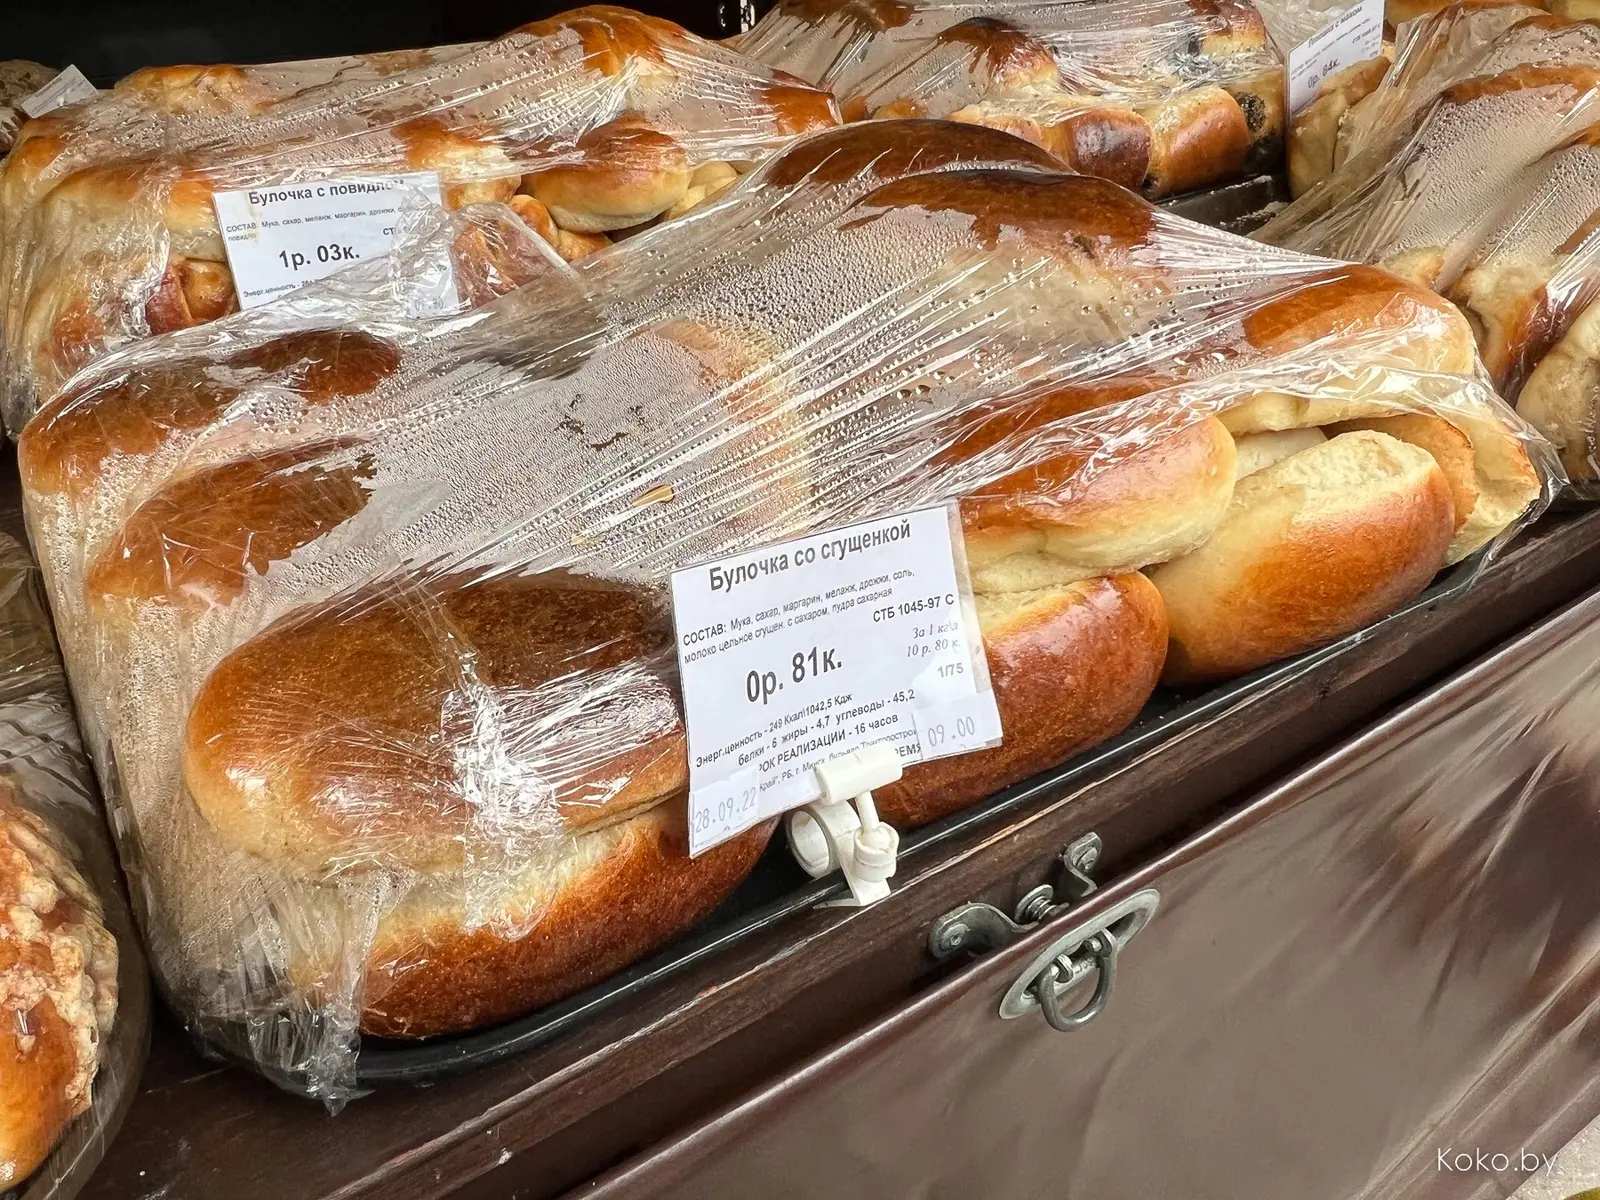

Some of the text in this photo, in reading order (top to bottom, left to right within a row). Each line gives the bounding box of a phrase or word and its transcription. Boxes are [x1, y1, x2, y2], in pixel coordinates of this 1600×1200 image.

[248, 186, 313, 206] Булочка
[316, 187, 325, 197] с
[261, 220, 280, 229] Мука,
[282, 217, 304, 226] сахар,
[279, 243, 360, 271] 1р. 03к.
[709, 518, 911, 593] Булочка со сгущенкой
[683, 568, 915, 646] СОСТАВ: Мука, сахар, маргарин, меланж, дрожжи, соль,
[684, 645, 717, 664] молоко
[718, 632, 753, 652] цельное
[754, 621, 786, 640] сгущен.
[787, 618, 793, 627] с
[831, 599, 855, 615] пудра
[856, 587, 893, 605] сахарная
[873, 593, 955, 623] СТБ 1045-97 С
[907, 644, 919, 657] 10
[921, 645, 931, 657] р.
[934, 638, 949, 652] 80
[912, 626, 925, 639] За
[929, 623, 933, 636] 1
[746, 646, 842, 705] 0р. 81к.
[937, 662, 964, 678] 1/75
[696, 730, 764, 768] Энерг.ценность
[769, 717, 783, 733] 249
[834, 693, 853, 707] Кдж
[738, 746, 765, 766] белки
[771, 740, 778, 749] 6
[781, 725, 809, 745] жиры
[816, 715, 830, 731] 4,7
[835, 698, 885, 725] углеводы
[892, 688, 916, 705] 45,2
[777, 728, 846, 766] РЕАЛИЗАЦИИ
[855, 722, 866, 736] 16
[868, 713, 899, 731] часов
[695, 786, 757, 833] 28.09.22
